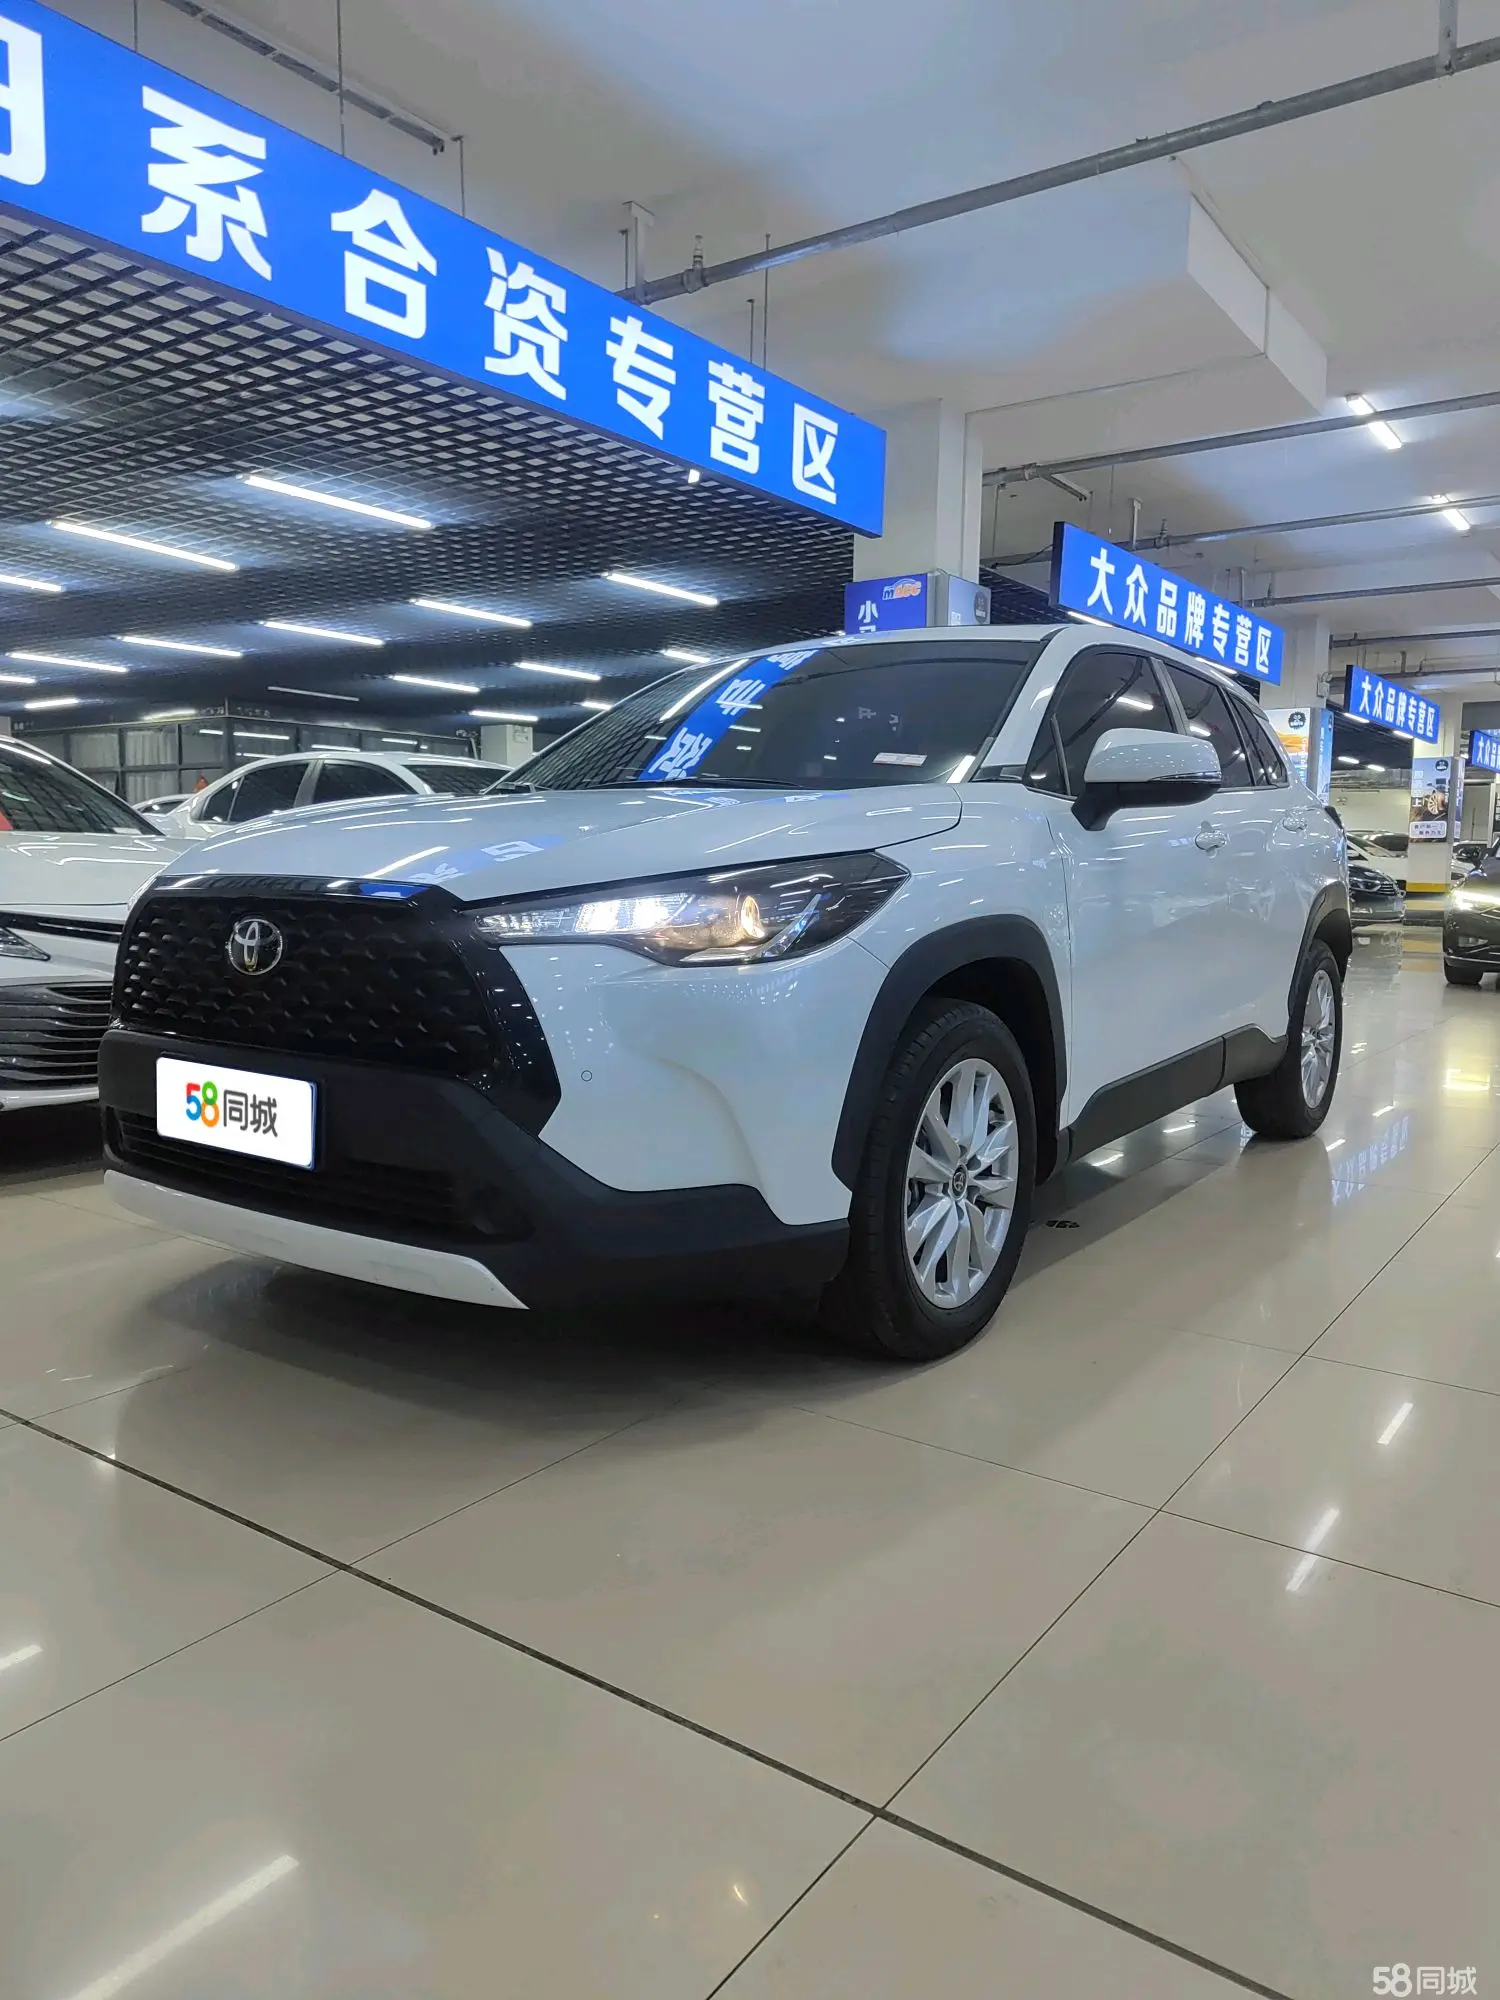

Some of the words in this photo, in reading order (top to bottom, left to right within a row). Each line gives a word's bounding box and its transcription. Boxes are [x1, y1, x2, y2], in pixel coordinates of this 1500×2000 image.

[1087, 547, 1272, 675] 大众品牌专营区
[1359, 675, 1436, 738] 大众品牌专营区
